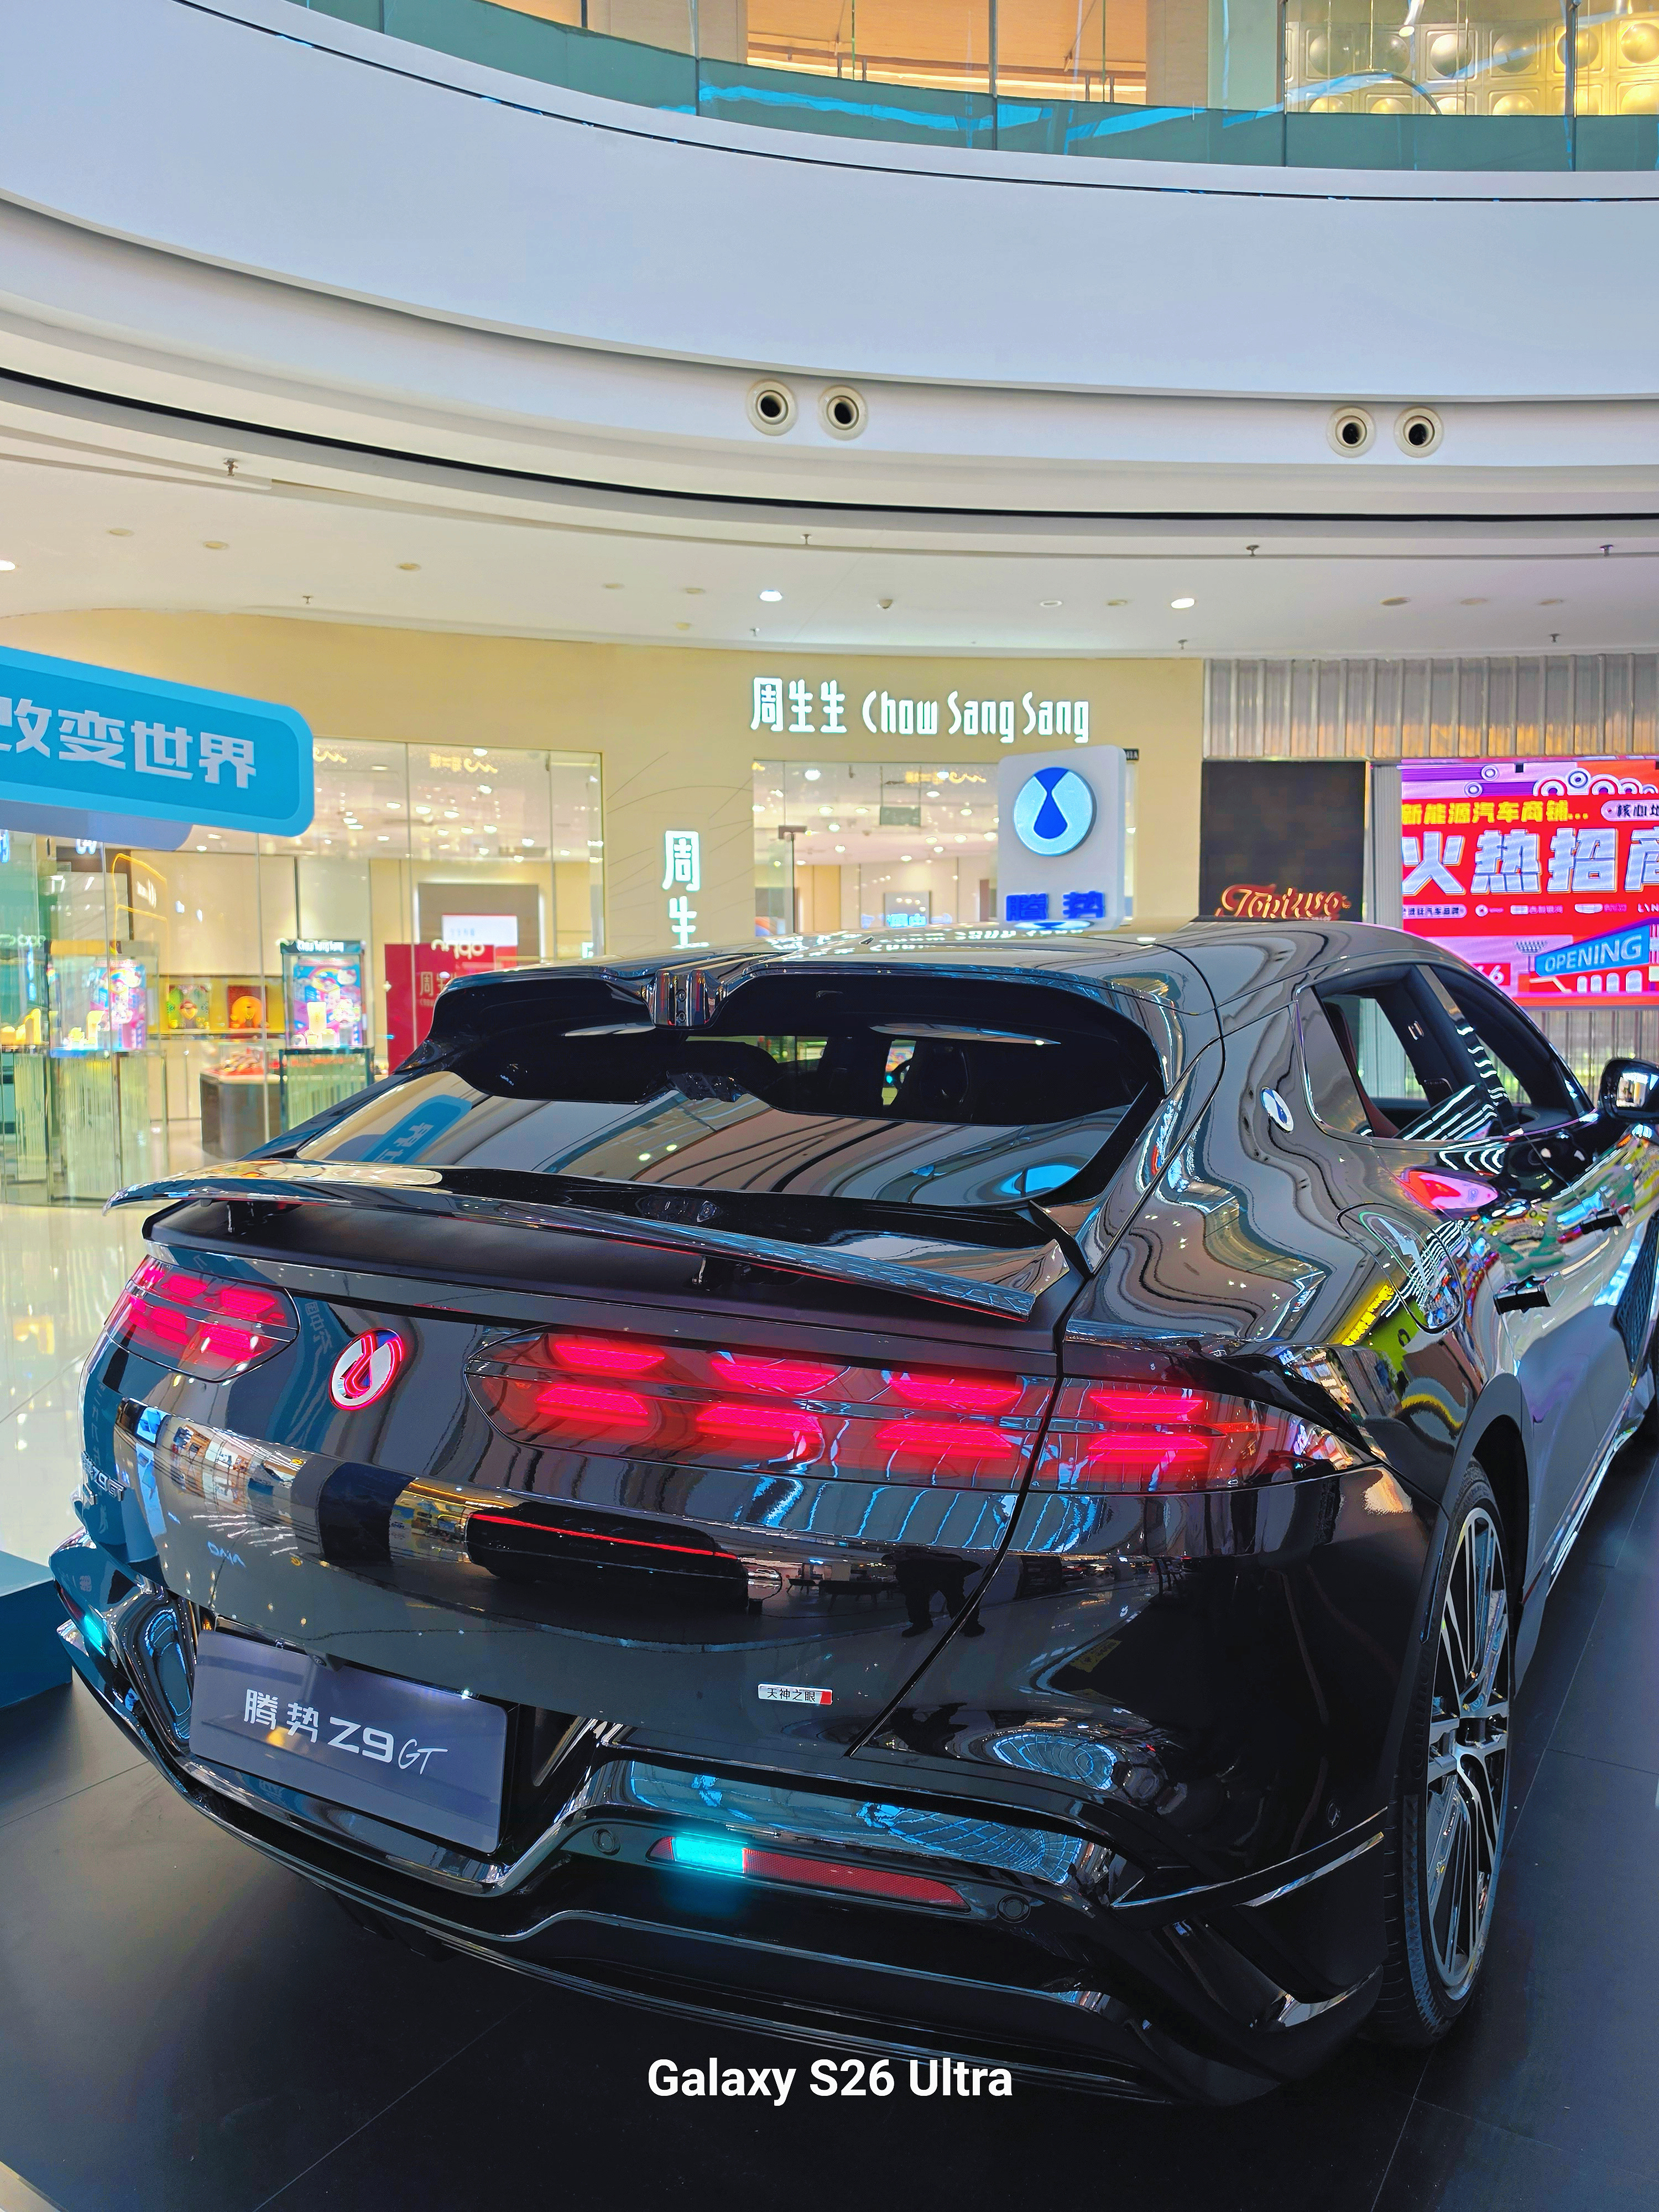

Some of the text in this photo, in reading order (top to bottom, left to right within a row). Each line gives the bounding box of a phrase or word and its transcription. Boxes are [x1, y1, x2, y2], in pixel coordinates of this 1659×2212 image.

[750, 677, 1089, 743] 周生生 Chow Sang Sang
[0, 696, 257, 789] 改变世界
[1006, 890, 1104, 922] 腾势
[1545, 935, 1642, 973] OPENING
[767, 1688, 816, 1702] 天神之眼
